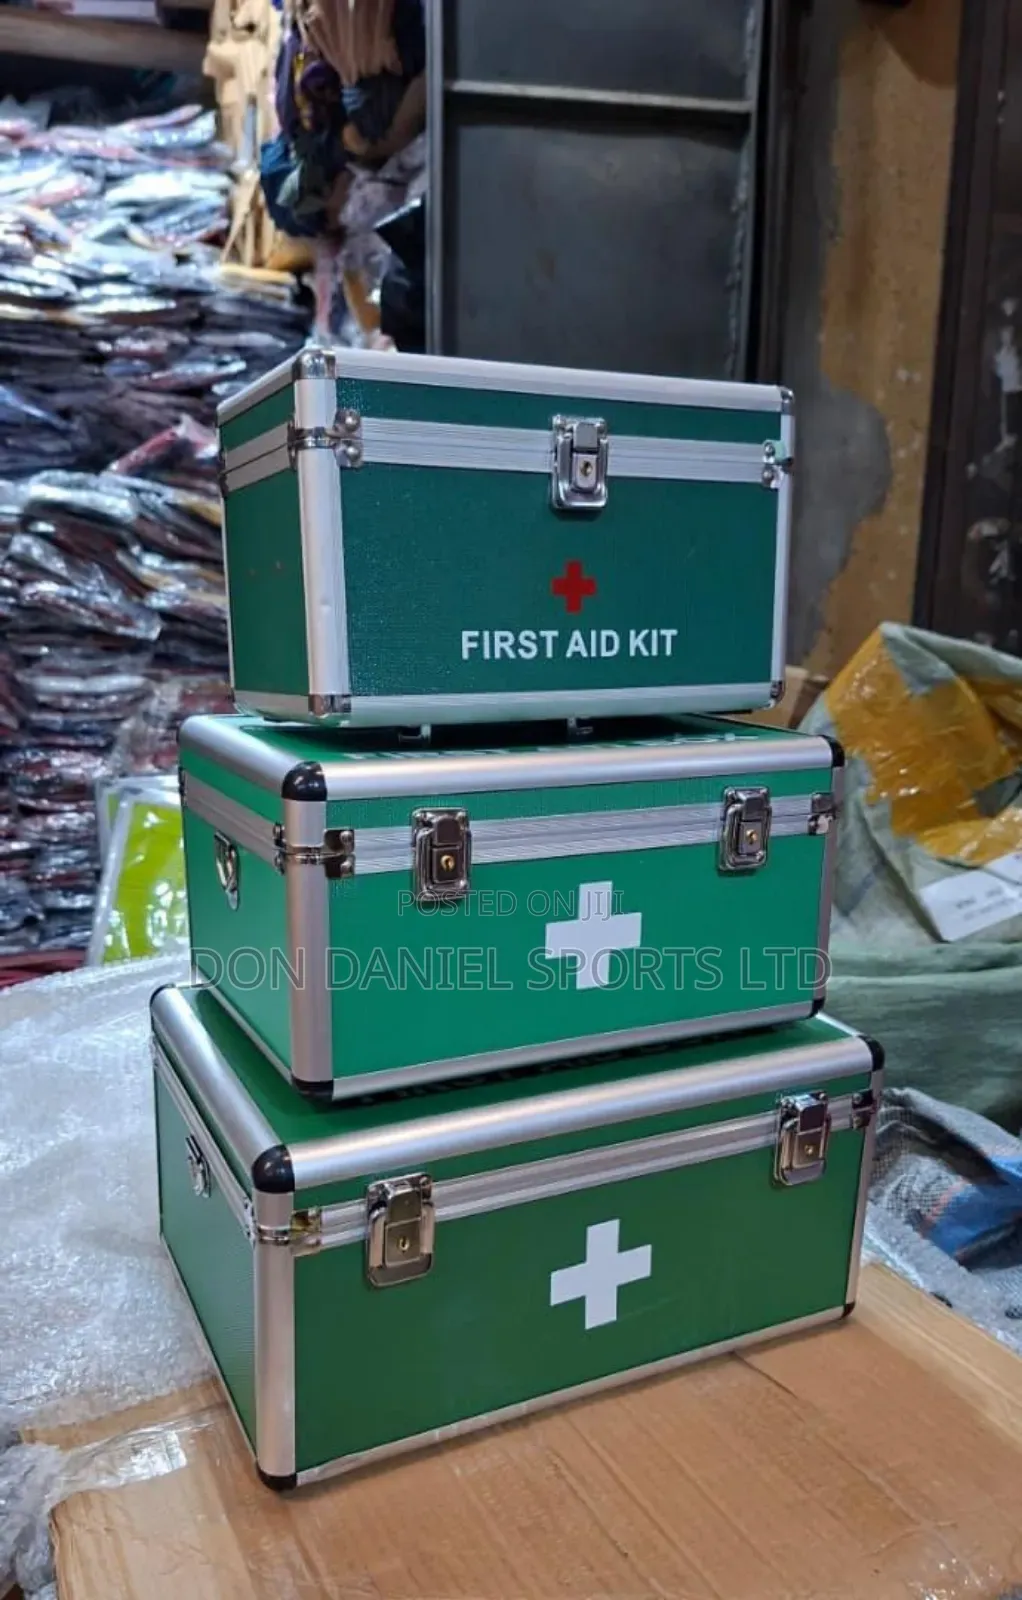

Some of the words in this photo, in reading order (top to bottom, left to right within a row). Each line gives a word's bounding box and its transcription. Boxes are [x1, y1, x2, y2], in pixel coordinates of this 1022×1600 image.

[461, 630, 559, 660] FIRST
[565, 629, 620, 658] AID
[629, 628, 678, 657] KIT
